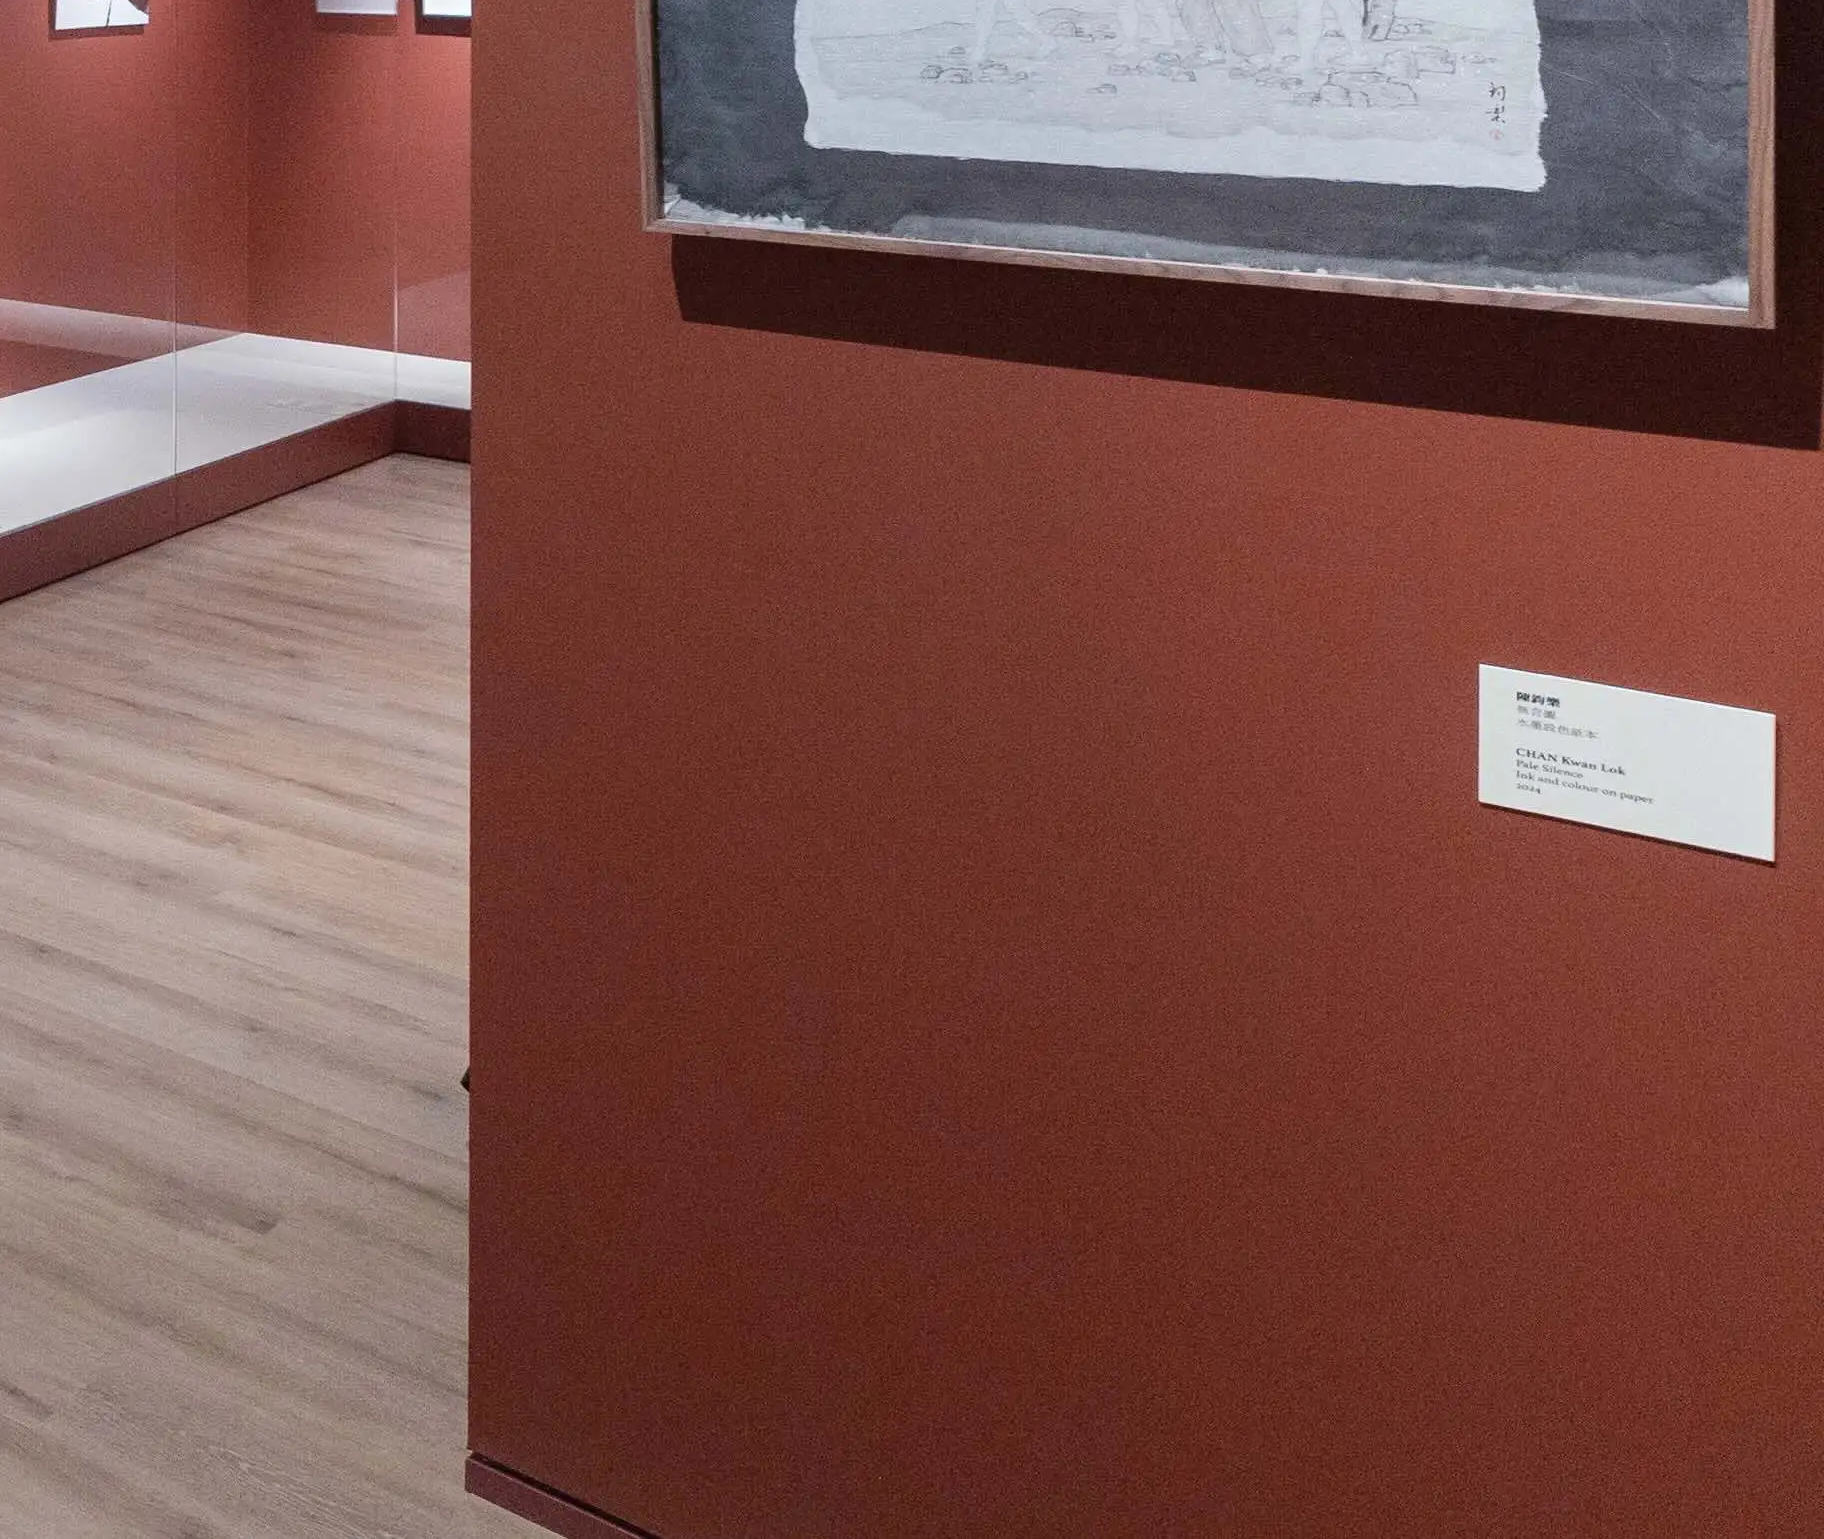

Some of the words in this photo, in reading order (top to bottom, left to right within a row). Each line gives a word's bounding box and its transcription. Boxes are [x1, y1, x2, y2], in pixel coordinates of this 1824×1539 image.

[1516, 748, 1557, 762] CHAN
[1561, 756, 1597, 771] Kwan
[1601, 763, 1626, 775] Lok
[1517, 760, 1538, 770] Pale
[1542, 765, 1583, 778] Silence
[1516, 783, 1541, 794] 2024
[1517, 771, 1536, 781] Ink
[1538, 776, 1558, 786] and
[1562, 781, 1598, 793] colour
[1620, 792, 1655, 804] paper
